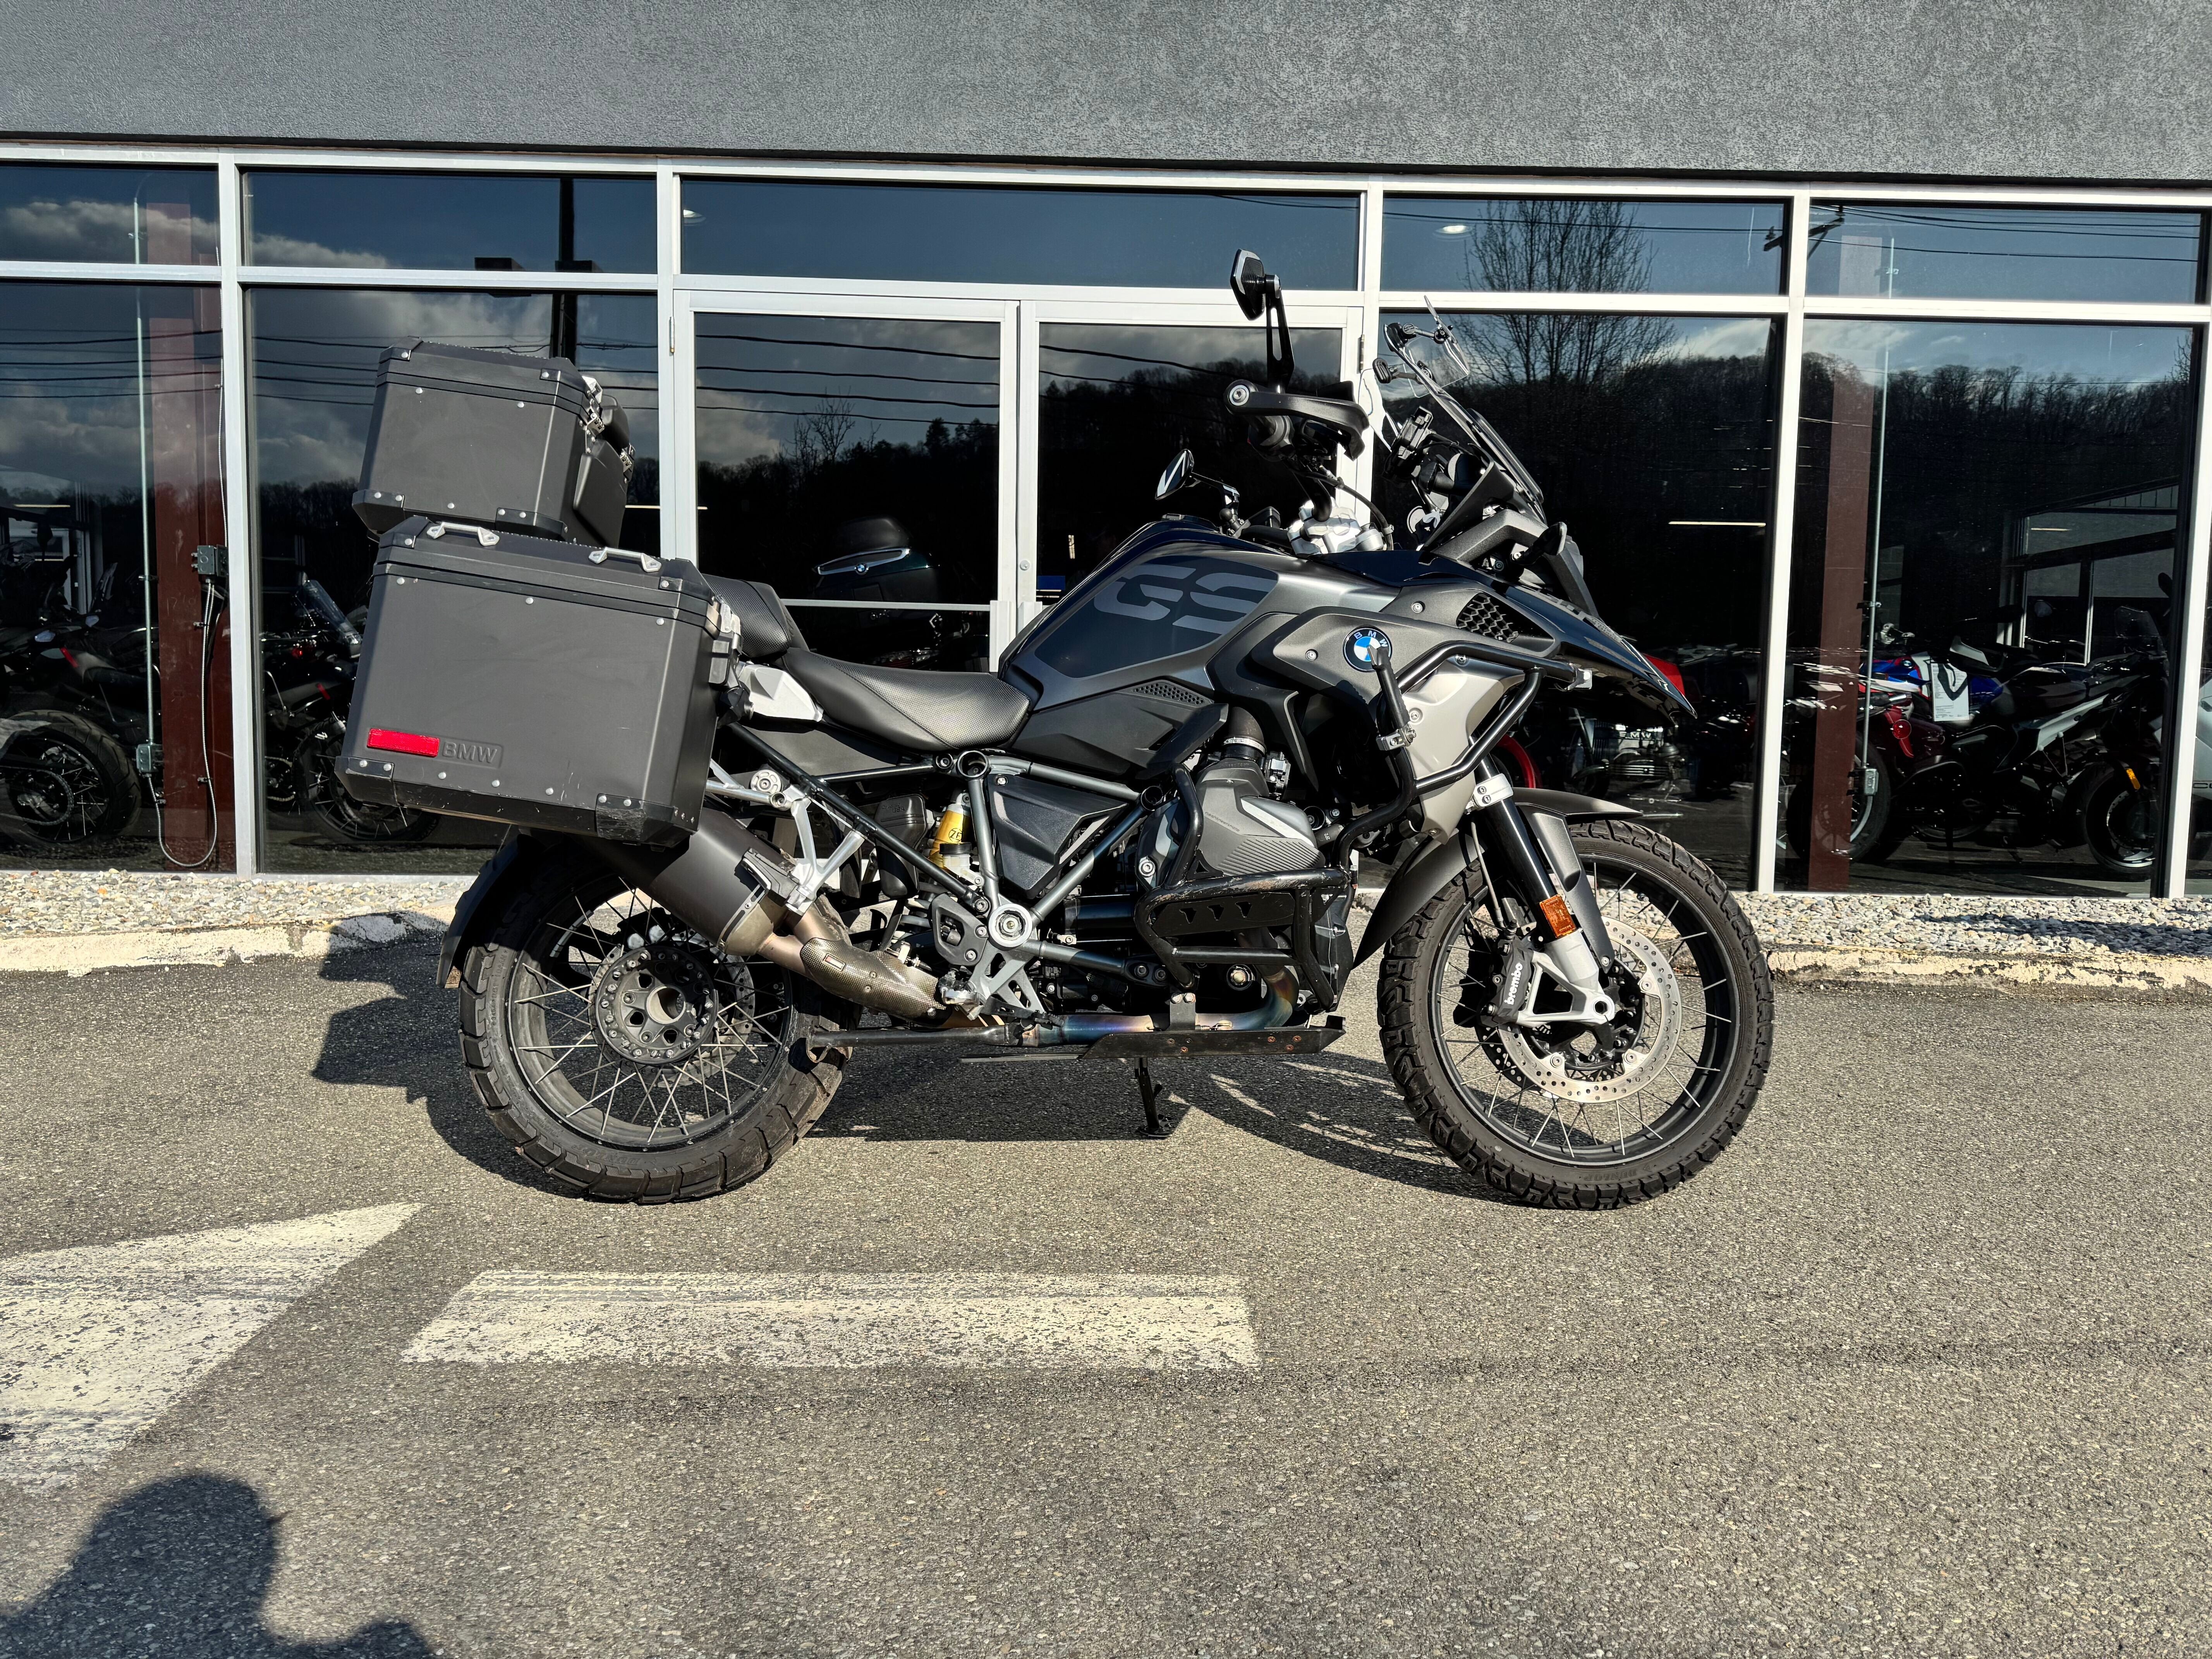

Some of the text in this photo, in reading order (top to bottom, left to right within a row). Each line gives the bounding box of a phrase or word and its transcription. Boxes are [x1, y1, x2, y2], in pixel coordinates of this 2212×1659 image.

[1094, 564, 1278, 635] GS
[1353, 630, 1388, 647] BMW
[443, 741, 498, 763] BMW
[949, 829, 962, 840] ZF
[1504, 962, 1523, 1005] brembo
[1584, 1168, 1637, 1181] DUNLOP
